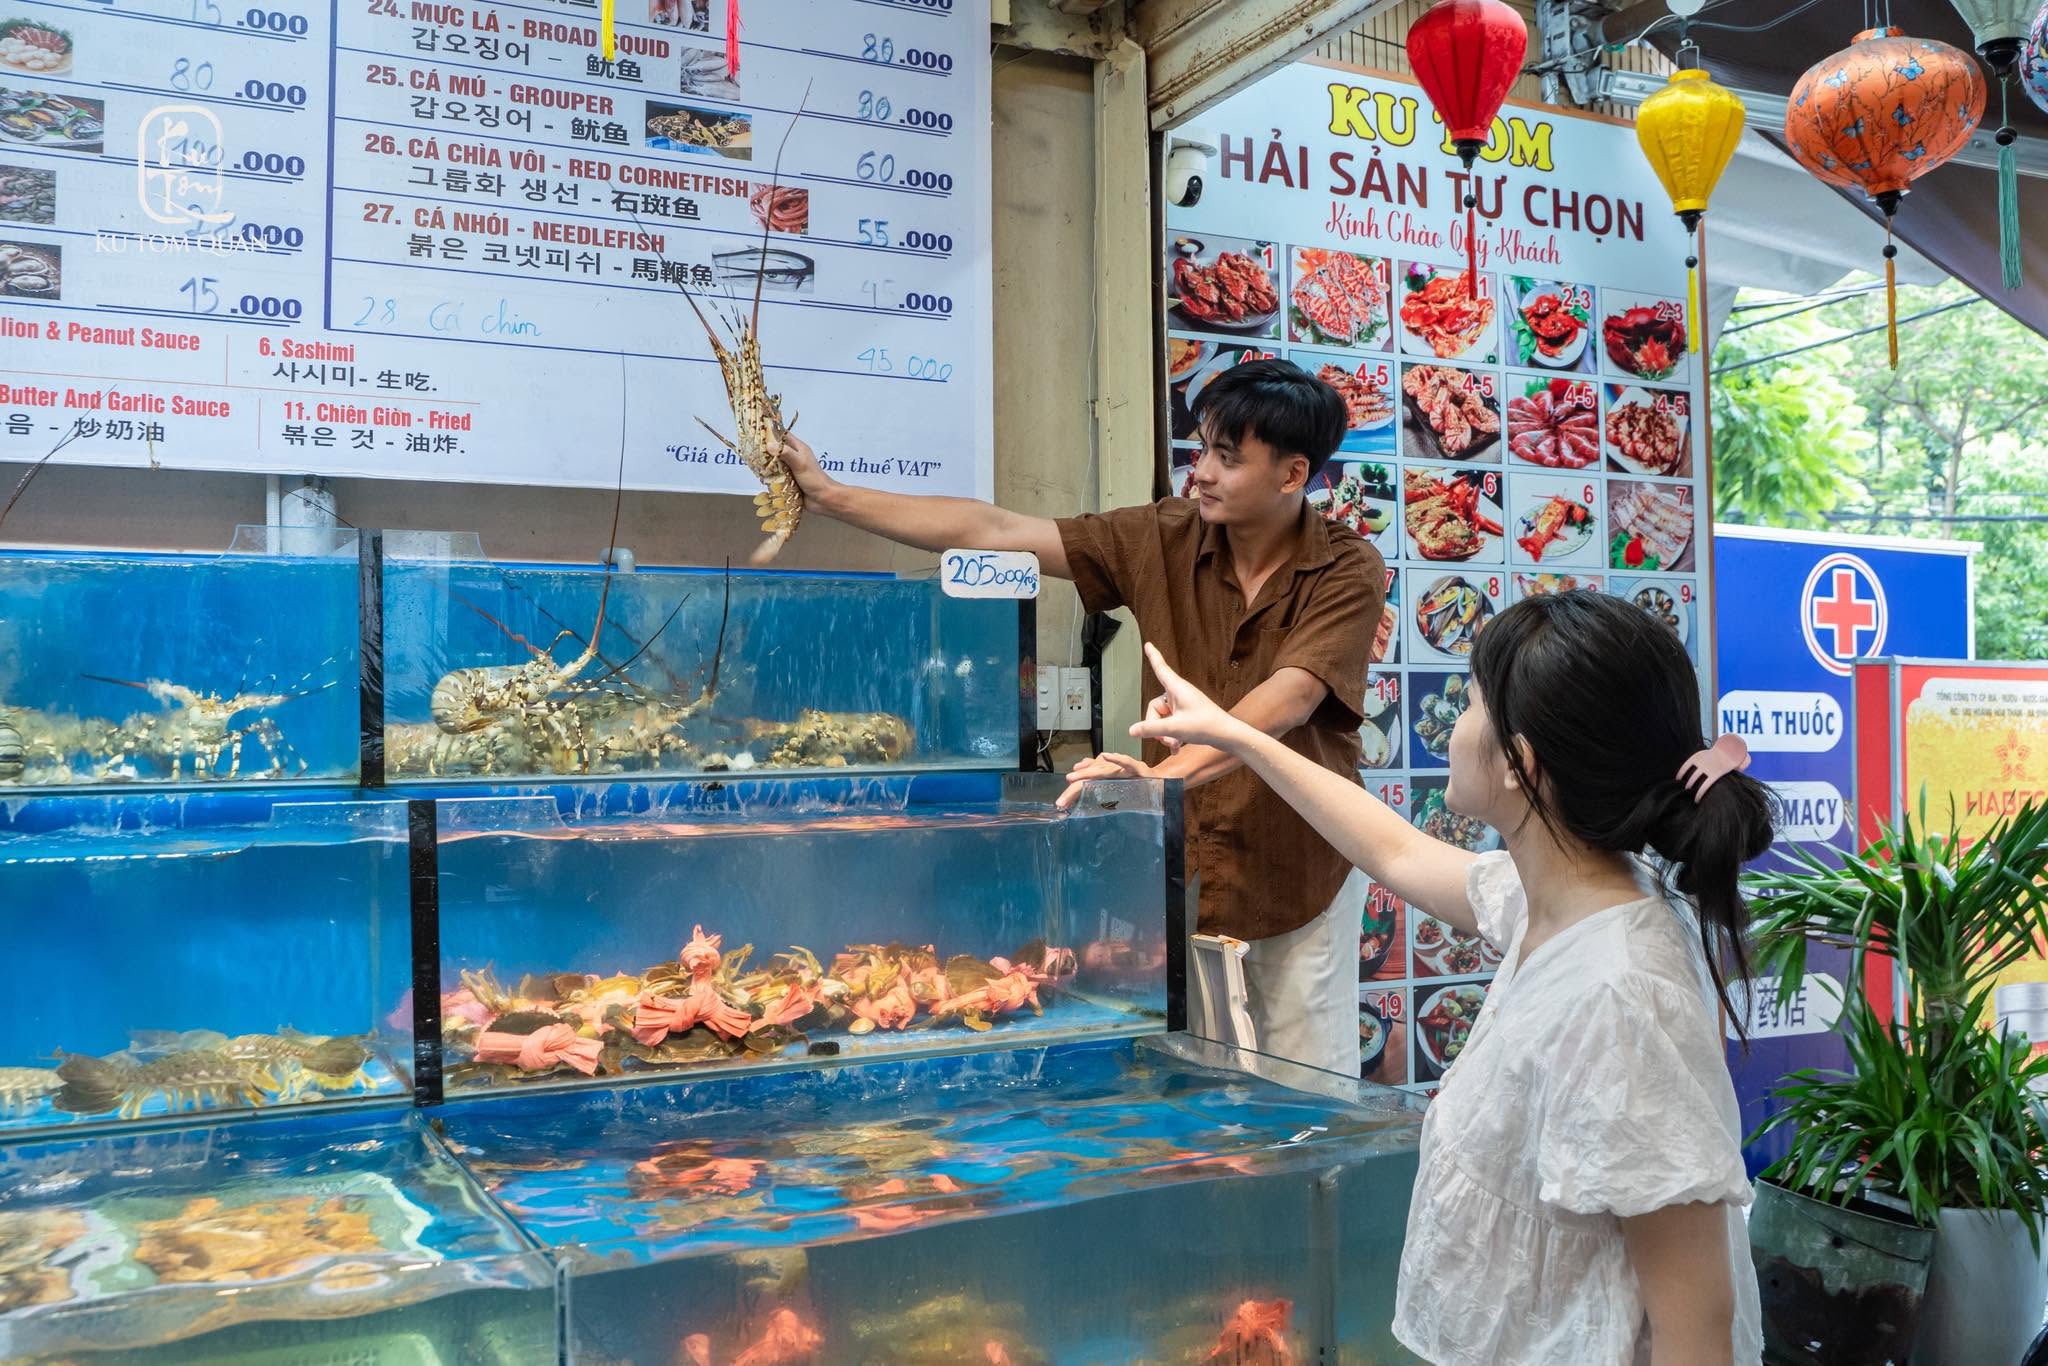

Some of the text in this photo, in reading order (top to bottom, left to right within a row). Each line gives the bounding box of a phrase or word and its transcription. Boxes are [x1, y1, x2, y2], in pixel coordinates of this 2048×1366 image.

[237, 9, 308, 35] .000
[368, 0, 405, 19] 24.
[411, 0, 464, 29] MỰC
[472, 9, 500, 33] LÁ
[523, 19, 597, 48] BROAD
[411, 26, 530, 66] 갑오징어
[900, 49, 953, 71] .000
[170, 57, 307, 105] 80 .000
[366, 64, 404, 87] 25.
[410, 68, 441, 92] CÁ
[449, 75, 487, 98] MÚ
[510, 84, 613, 115] GROUPER
[410, 95, 531, 133] 갑오징어
[571, 117, 630, 146] 鱿鱼
[900, 108, 953, 130] .000
[1328, 83, 1418, 147] KU
[234, 151, 305, 176] .000
[365, 134, 403, 156] 26.
[408, 137, 440, 161] CÁ
[448, 142, 502, 168] CHÌA
[509, 149, 545, 173] VÔI
[569, 158, 611, 182] RED
[619, 165, 748, 198] CORNETFISH
[857, 151, 953, 191] 60 .000
[408, 165, 506, 197] 그룹화
[519, 178, 579, 205] 생선
[611, 190, 701, 220] 石斑鱼
[1221, 128, 1644, 242] HẢI SẢN TỰ CHỌN
[232, 223, 304, 247] .000
[363, 203, 401, 225] 27.
[414, 206, 446, 229] CÁ
[453, 212, 509, 237] NHÓI
[533, 221, 665, 253] NEEDLEFISH
[858, 219, 953, 251] 55 .000
[1326, 201, 1561, 267] Kính Chào Qý Khách
[407, 233, 468, 260] 붉은
[482, 242, 600, 275] 코넷피쉬
[1263, 247, 1273, 269] 1
[1375, 263, 1385, 284] 1
[180, 277, 302, 319] 15 .000
[1479, 278, 1488, 297] 1
[1562, 288, 1591, 310] 2-3
[353, 296, 396, 326] 28
[899, 292, 953, 313] .000
[1656, 301, 1684, 322] 2-3
[47, 321, 61, 340] &
[68, 322, 135, 346] Peanut
[141, 328, 200, 351] Sauce
[259, 337, 355, 362] 6. Sashimi
[857, 347, 953, 381] 45 000
[1355, 363, 1389, 385] 4-5
[1462, 374, 1493, 396] 4-5
[1564, 385, 1595, 408] 4-5
[0, 384, 230, 418] Butter And Garlic Sauce
[1656, 395, 1686, 416] 4-5
[0, 413, 34, 436] 음
[74, 417, 165, 442] 炒奶油
[284, 401, 311, 421] 11.
[317, 403, 367, 425] Chiên
[373, 406, 412, 428] Giòn
[429, 411, 471, 431] Fried
[281, 424, 337, 447] 볶은
[350, 429, 375, 450] 것
[817, 451, 844, 472] ồm
[850, 457, 893, 476] thuế
[1482, 473, 1497, 496] 6
[1583, 485, 1594, 504] 6
[1676, 488, 1687, 506] 7
[1489, 577, 1500, 597] 8
[1681, 585, 1692, 604] 9
[1375, 678, 1398, 702] 11
[1722, 698, 1835, 736] NHÀ THUỐC
[1379, 784, 1405, 806] 15
[1377, 994, 1403, 1018] 19
